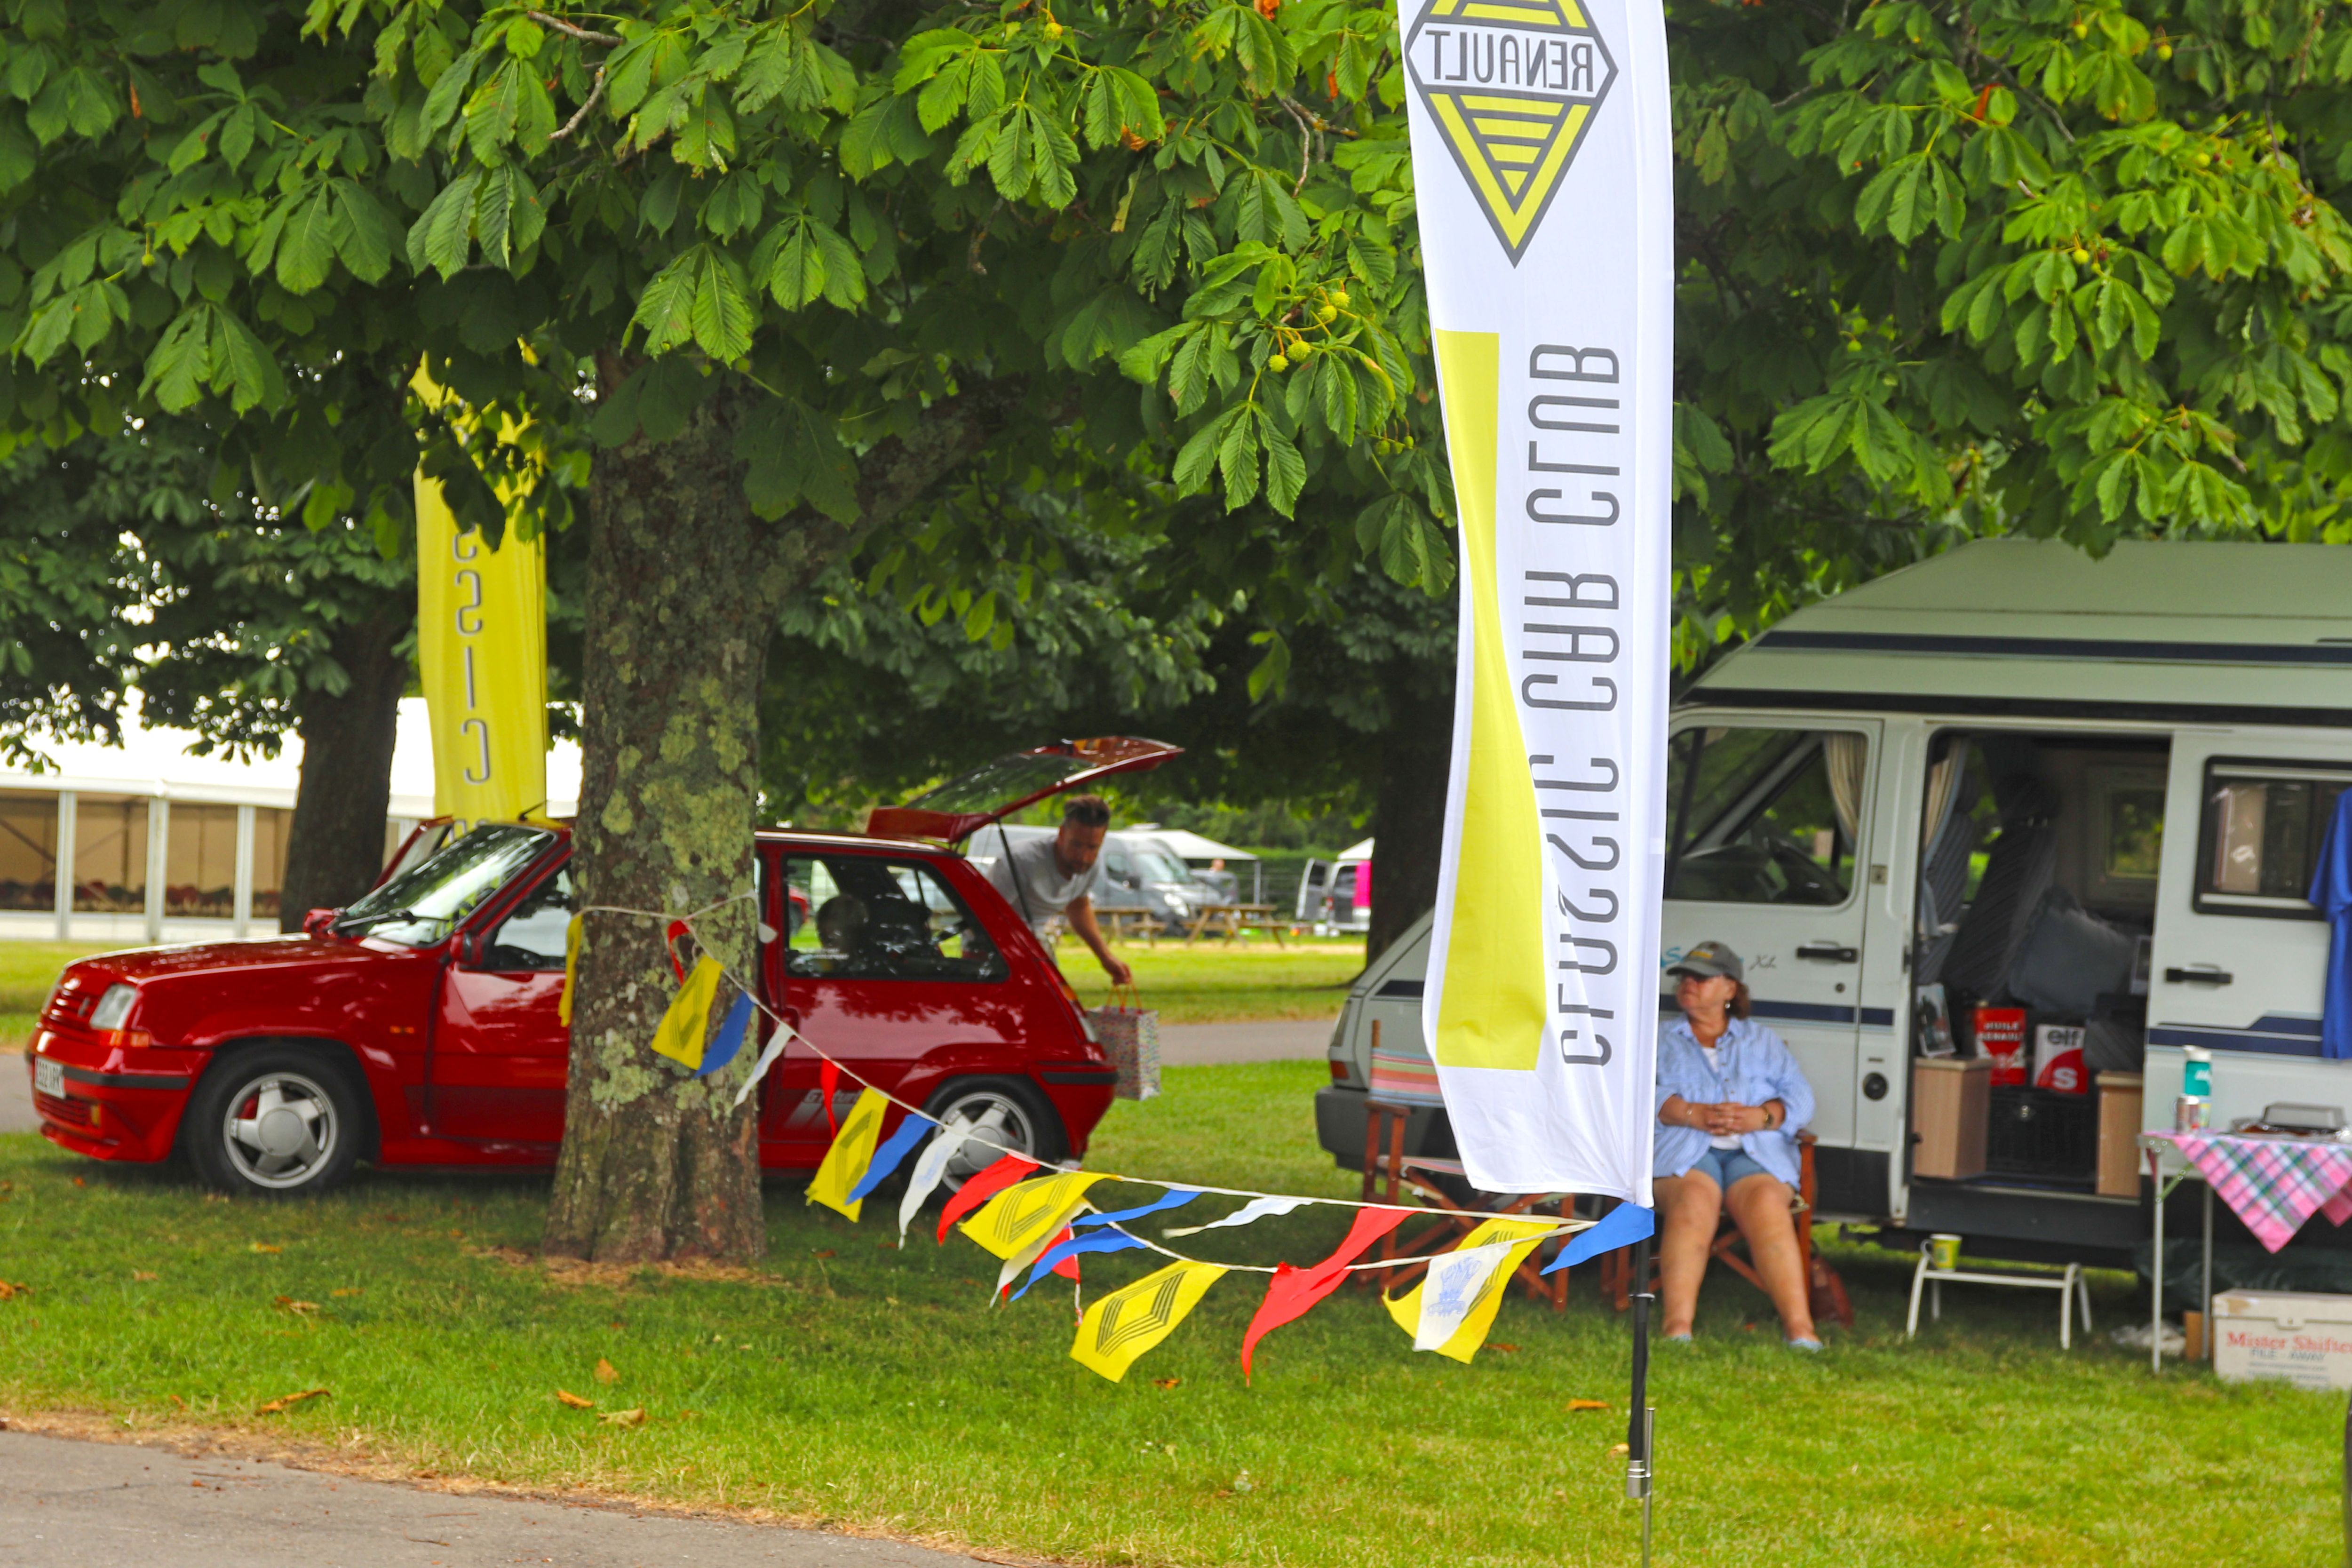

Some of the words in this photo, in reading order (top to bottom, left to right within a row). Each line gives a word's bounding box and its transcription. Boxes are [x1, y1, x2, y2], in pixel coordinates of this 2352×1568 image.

[2047, 1030, 2081, 1047] elf
[2052, 1067, 2078, 1089] S
[2227, 1332, 2286, 1349] Mister
